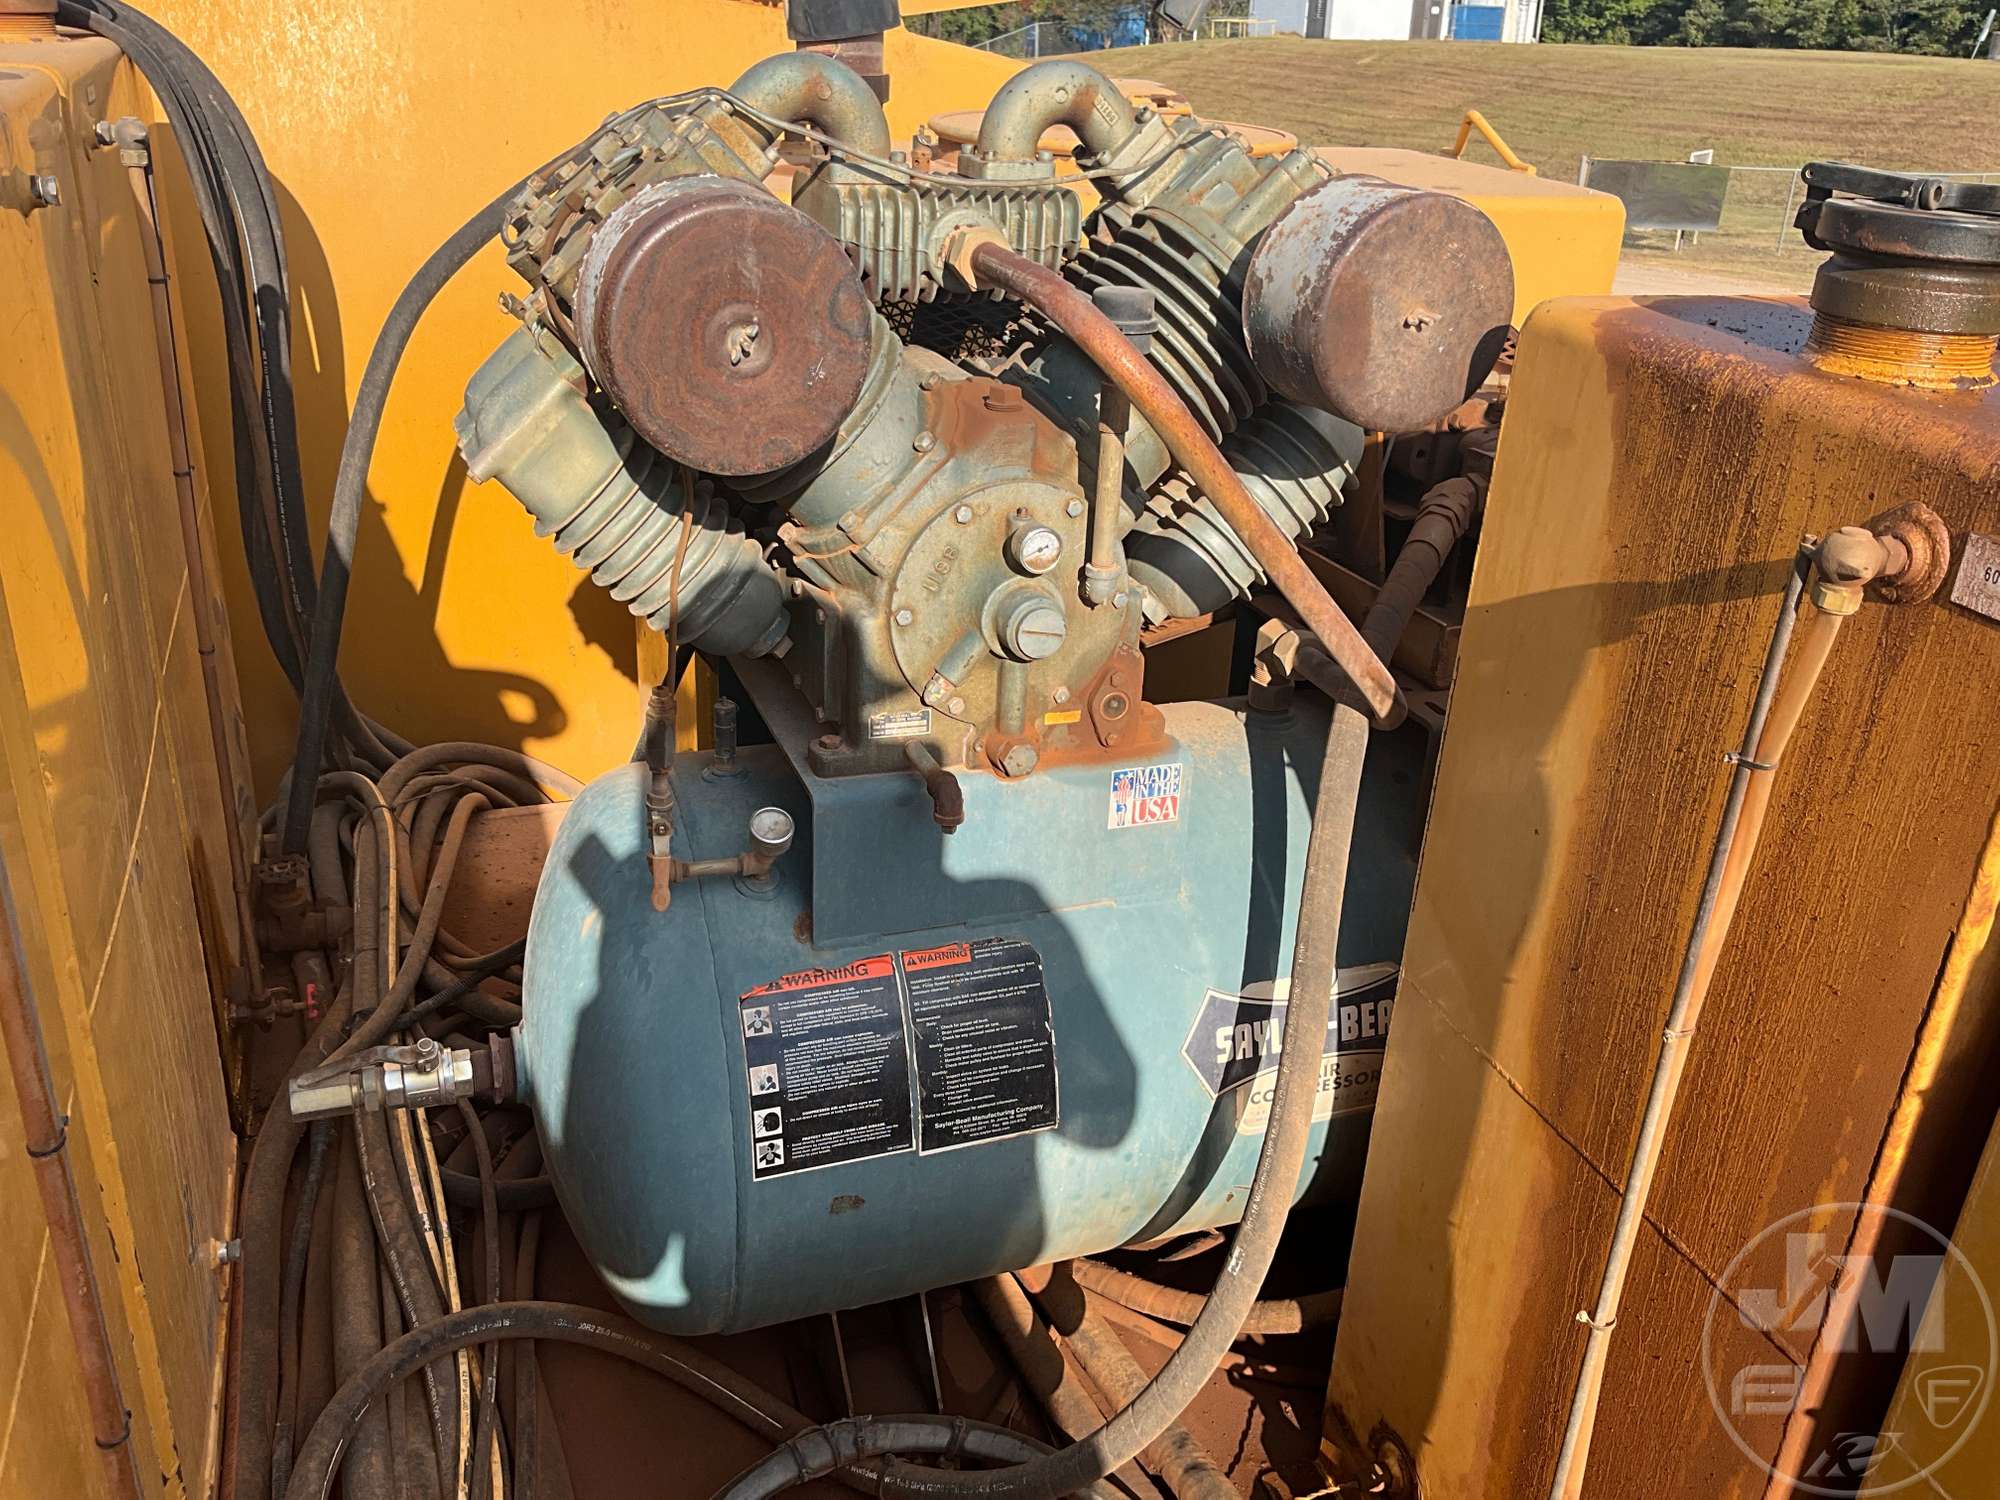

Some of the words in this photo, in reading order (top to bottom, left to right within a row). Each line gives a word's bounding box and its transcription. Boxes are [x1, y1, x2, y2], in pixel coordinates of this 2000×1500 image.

[1137, 765, 1180, 786] MADE
[1136, 784, 1149, 799] IN
[1153, 781, 1178, 797] THE
[1134, 797, 1176, 823] USA
[917, 948, 967, 964] WARNING
[785, 963, 868, 988] WARNING
[934, 1116, 971, 1130] Saylor-Beall
[971, 1108, 1014, 1122] Manufacturing
[1015, 1102, 1043, 1114] Company
